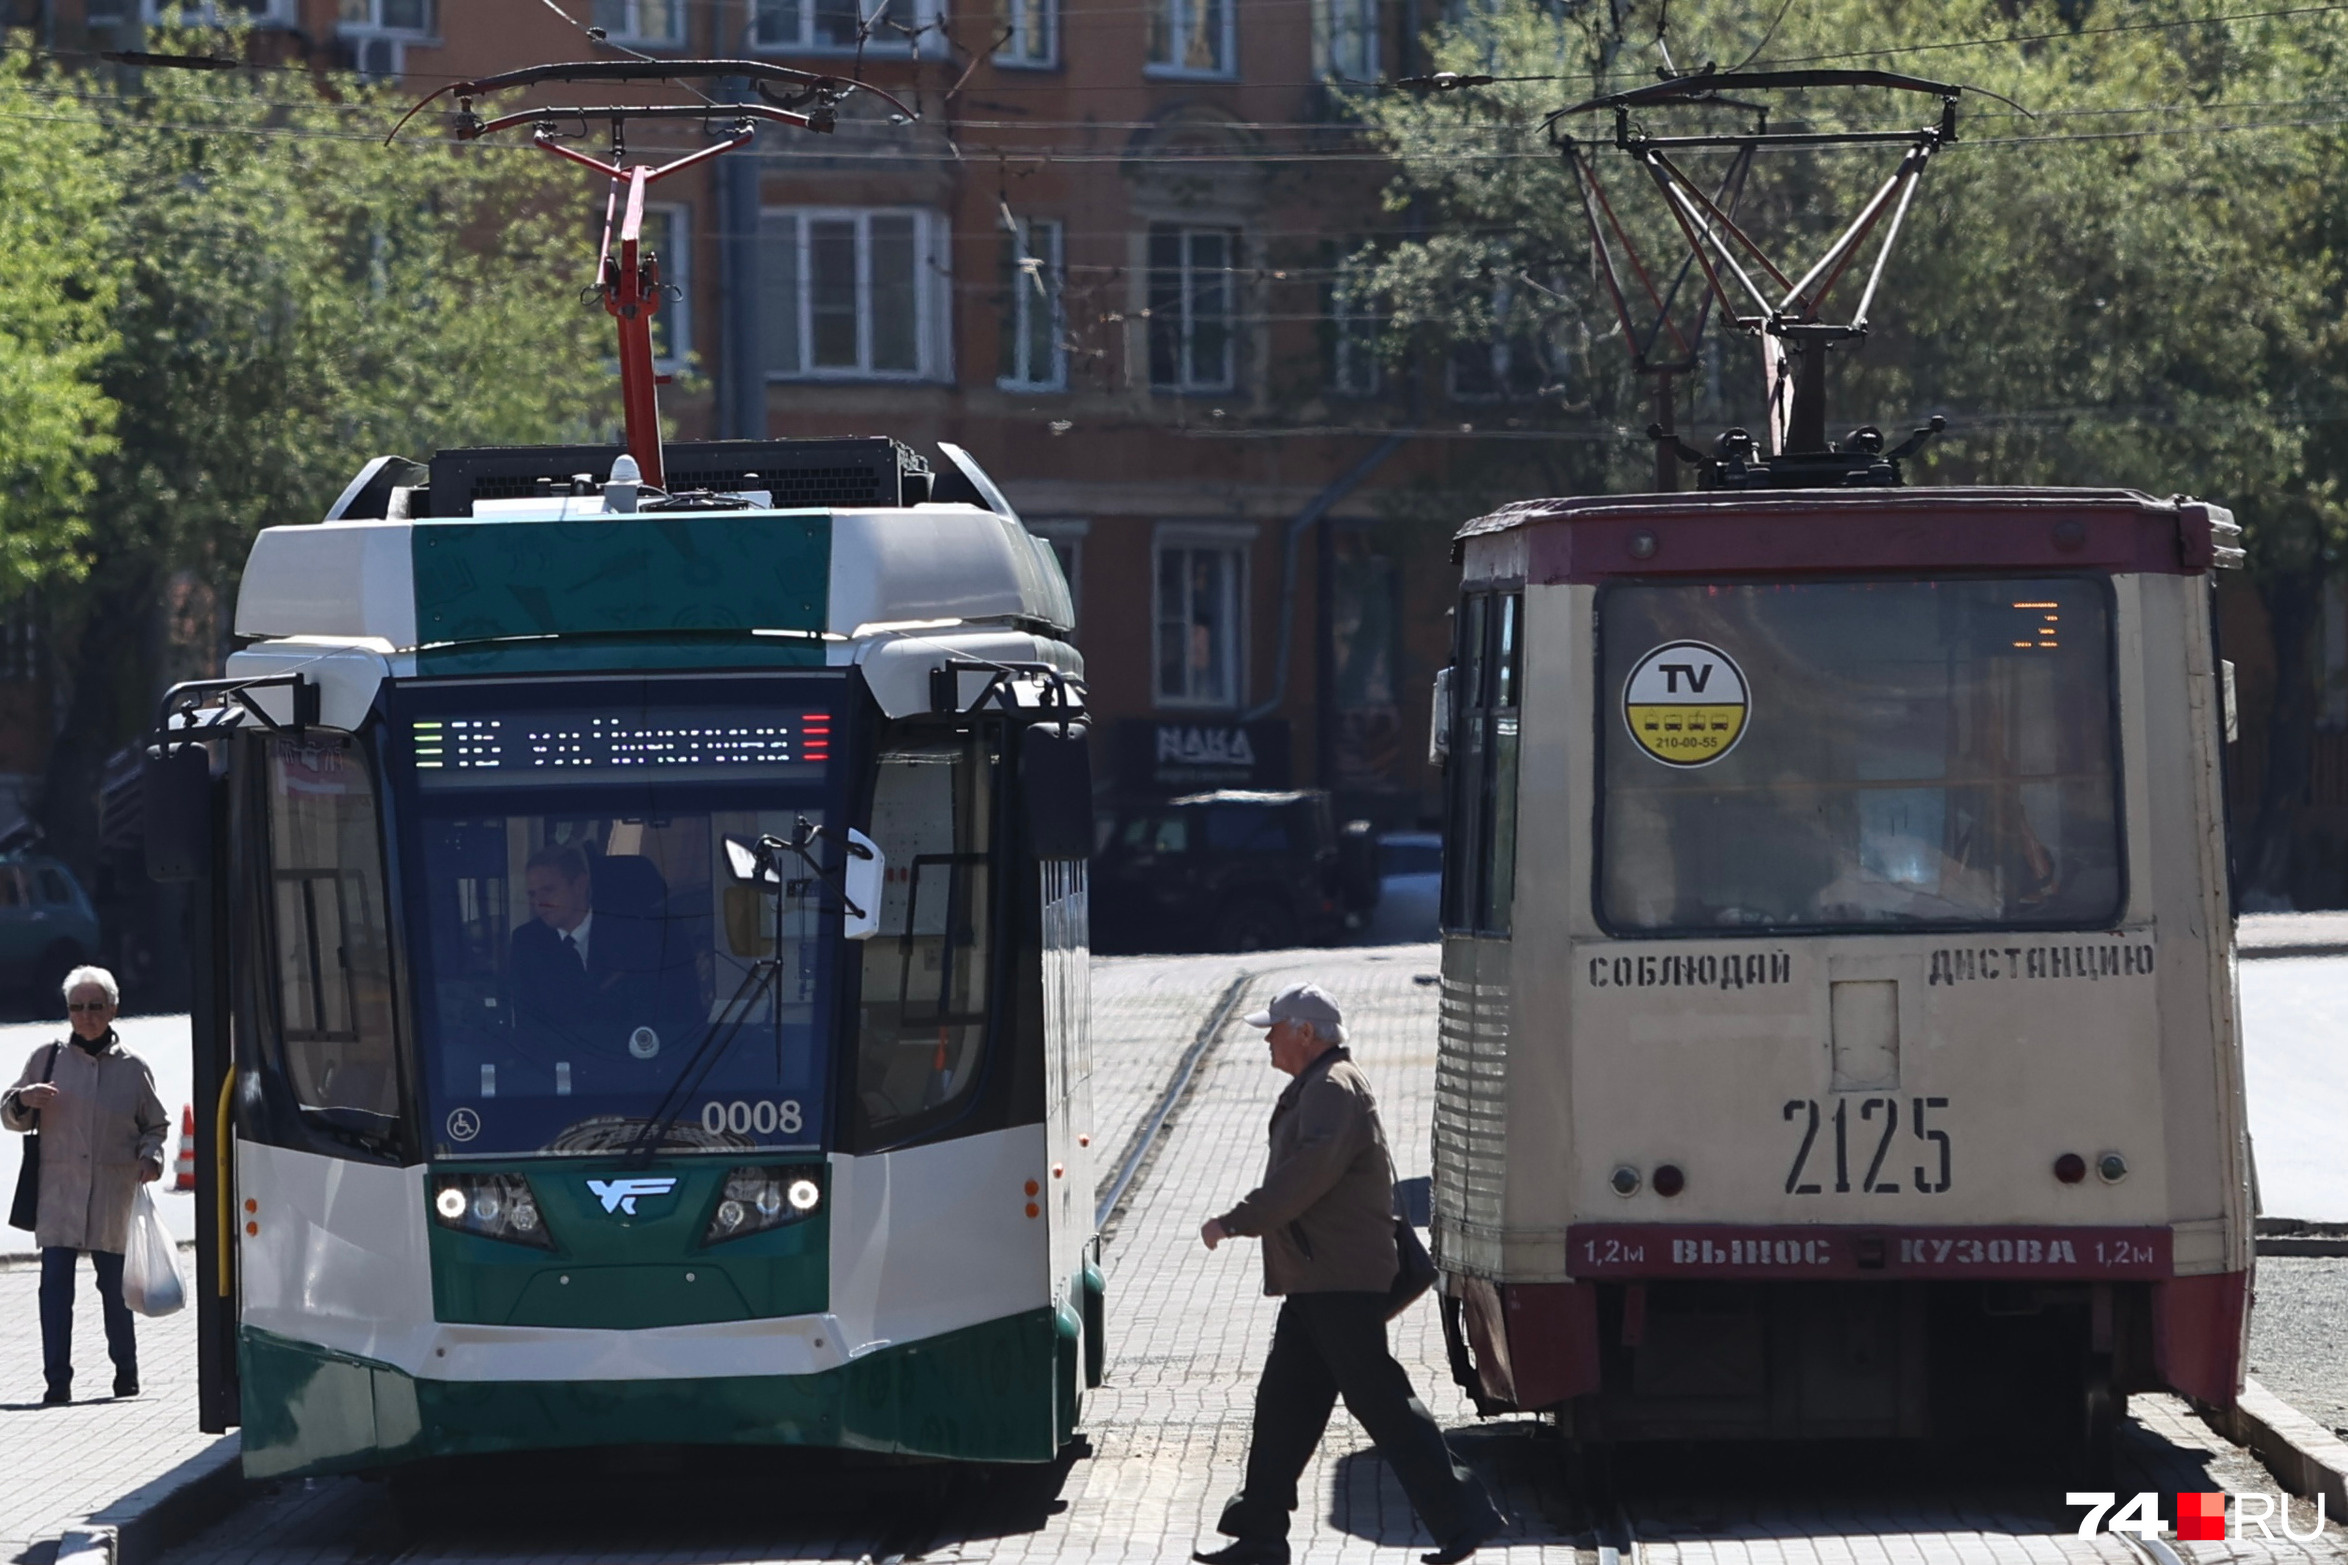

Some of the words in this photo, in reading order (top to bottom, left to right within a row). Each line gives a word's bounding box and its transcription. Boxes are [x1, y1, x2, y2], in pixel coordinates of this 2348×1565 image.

[1658, 664, 1714, 694] TV
[1655, 737, 1718, 749] 210-00-55
[1588, 948, 1791, 991] СОБЛЮДАЙ
[1928, 944, 2154, 986] ДИСТАНЦИЮ
[701, 1098, 803, 1136] 0008
[1783, 1097, 1952, 1194] 2125
[1672, 1239, 1832, 1265] ВЫНОС
[1900, 1239, 2078, 1264] КУЗОВА
